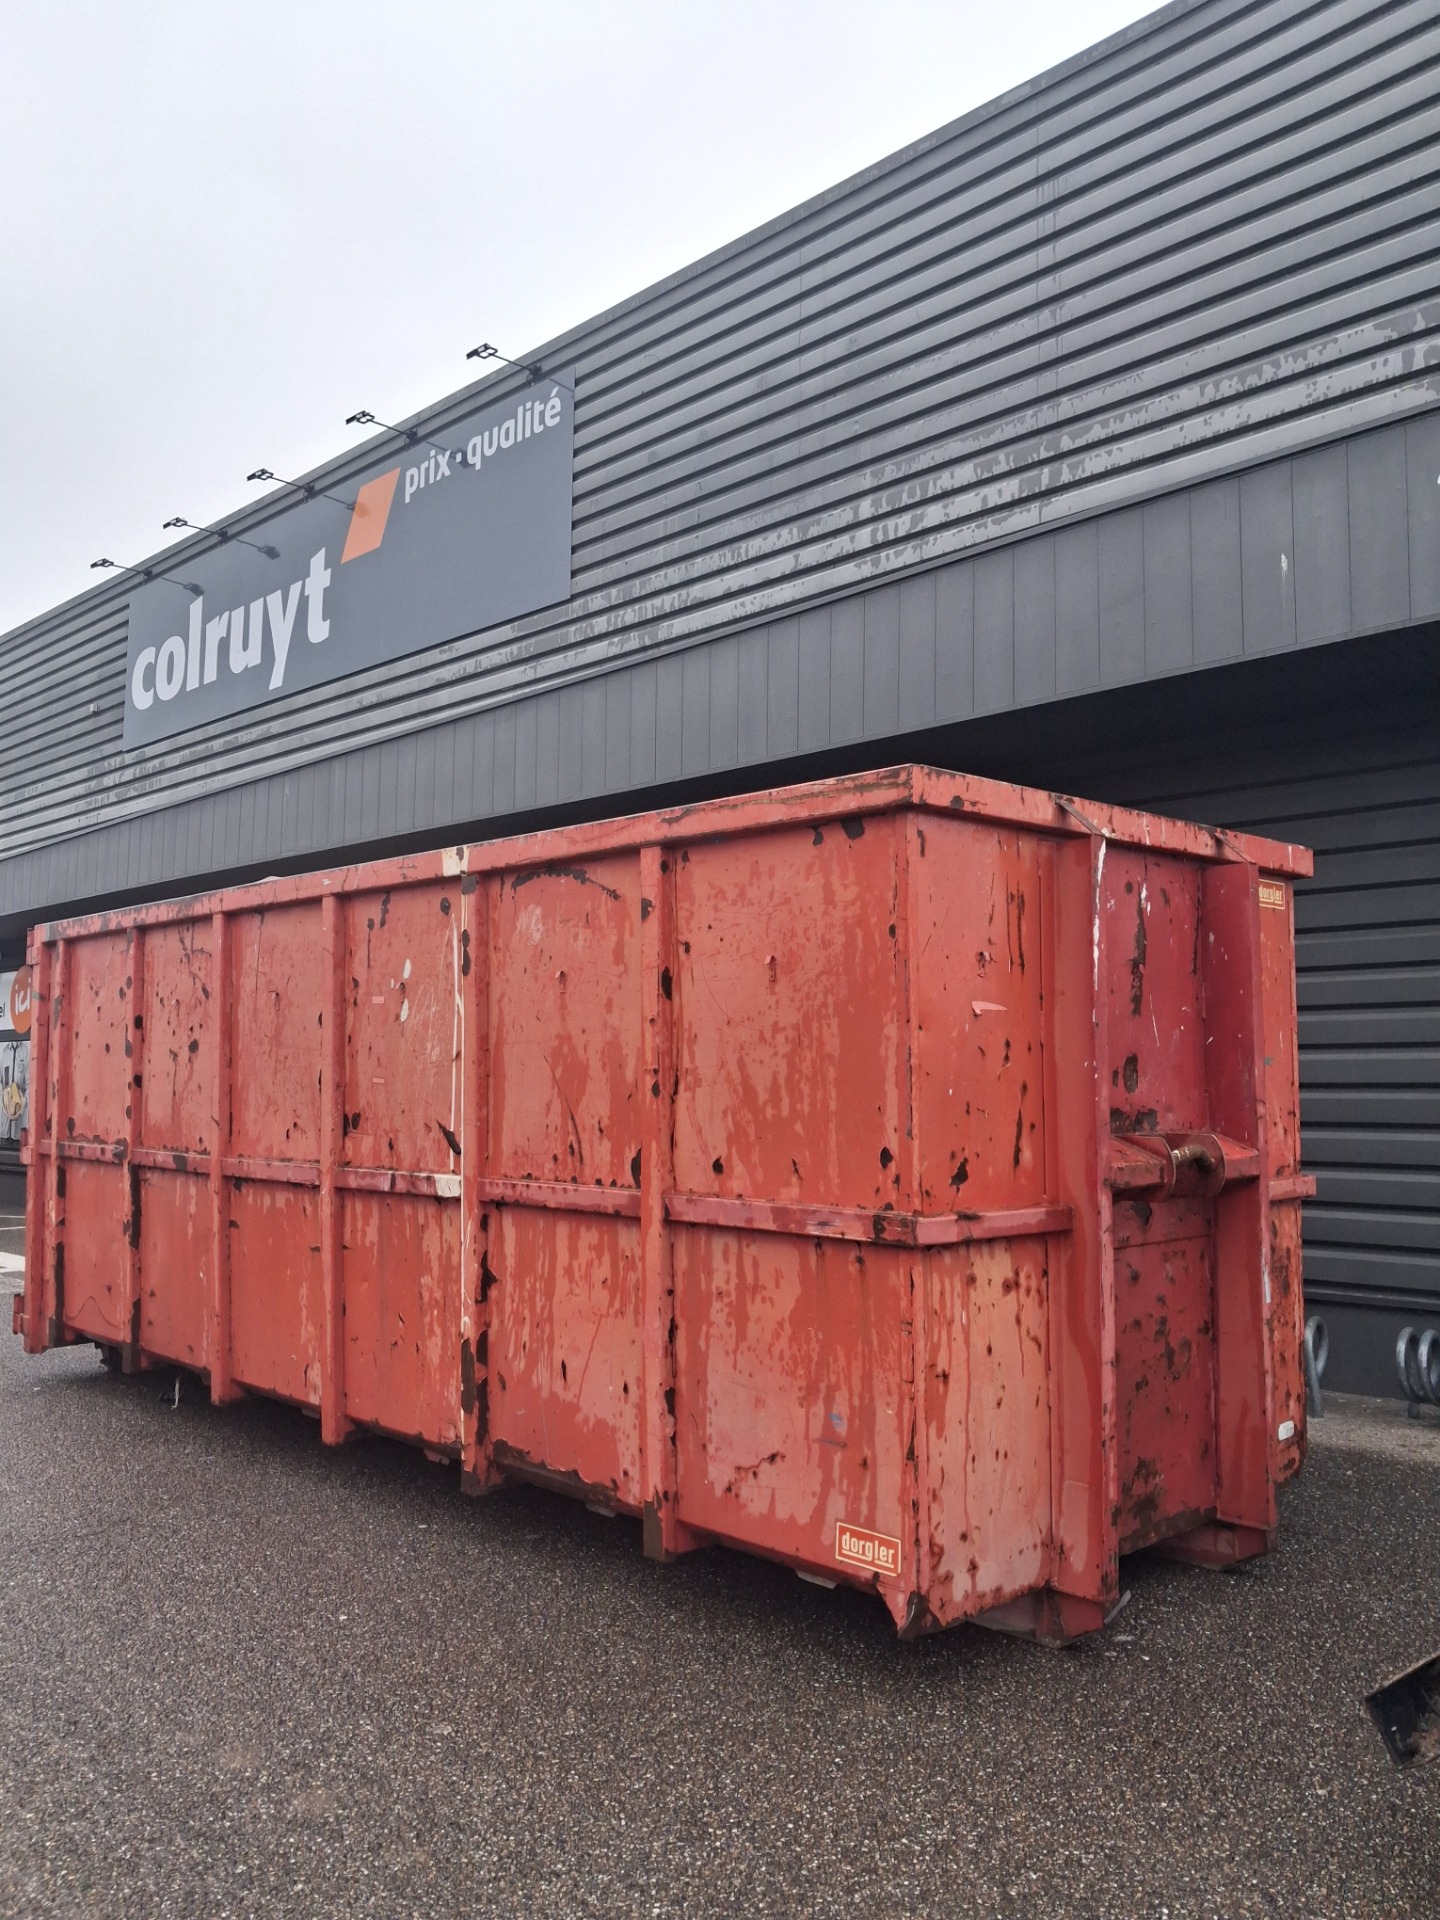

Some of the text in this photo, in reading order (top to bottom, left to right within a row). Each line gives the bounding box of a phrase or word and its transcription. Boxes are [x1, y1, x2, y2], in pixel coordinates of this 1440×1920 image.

[131, 547, 332, 710] colruyt
[15, 976, 31, 1016] ici
[841, 1531, 895, 1564] dorgler
